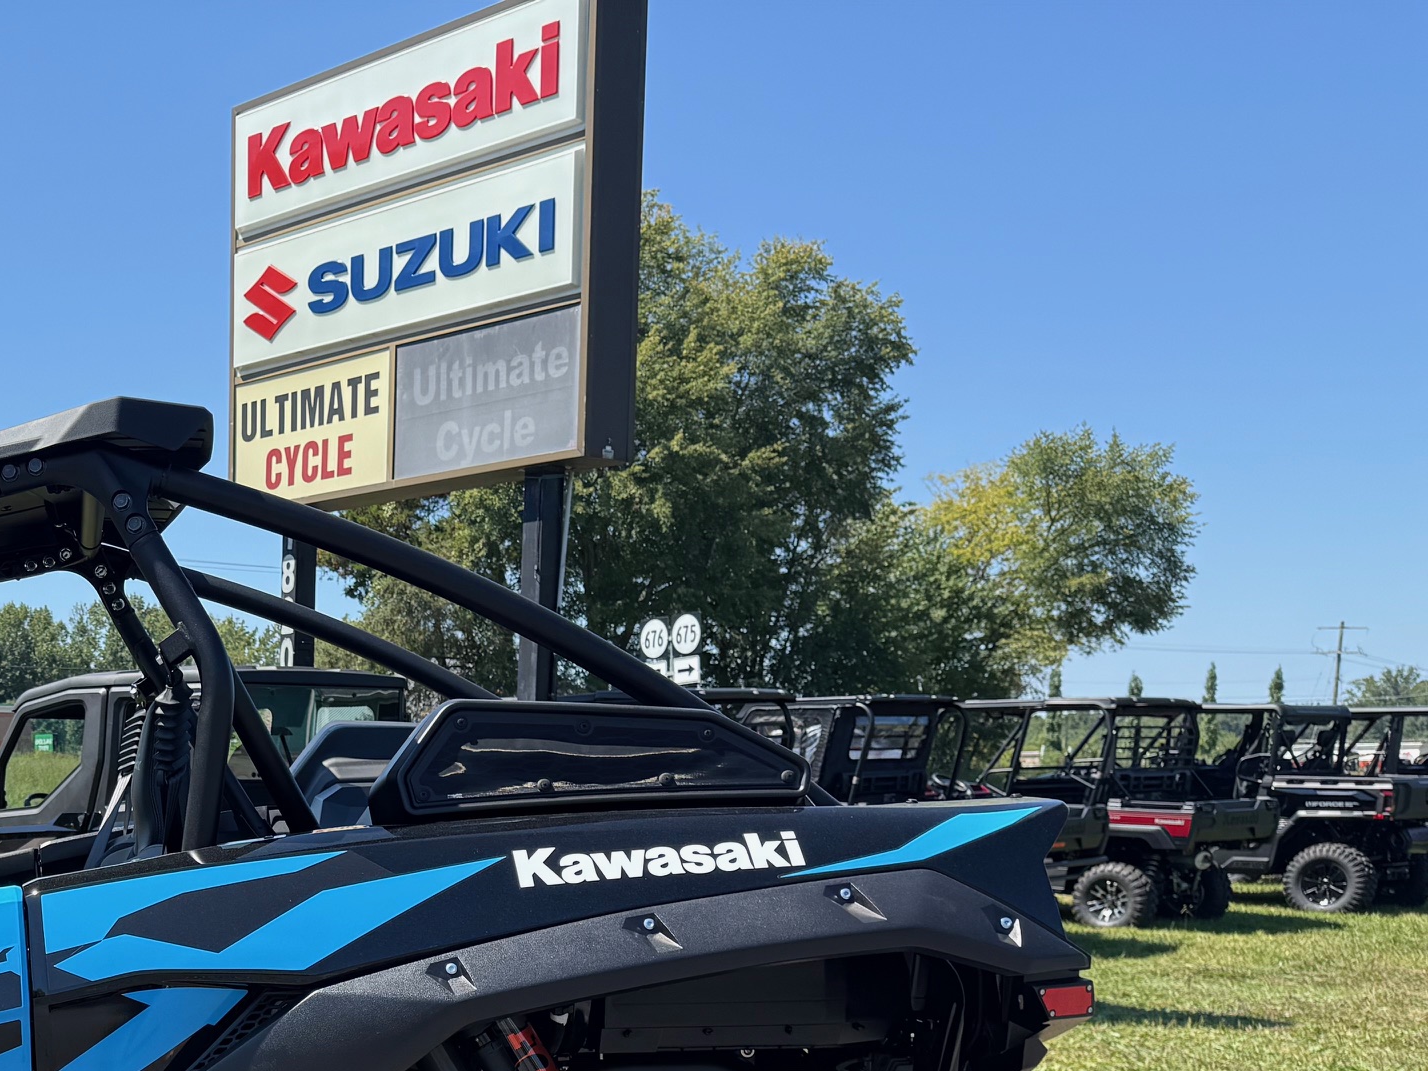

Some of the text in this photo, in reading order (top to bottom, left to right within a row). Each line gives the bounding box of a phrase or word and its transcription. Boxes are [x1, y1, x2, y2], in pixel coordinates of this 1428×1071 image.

[247, 20, 562, 200] Kawasaki
[307, 197, 556, 316] SUZUKI
[413, 341, 570, 406] Ultimate
[241, 371, 380, 443] ULTIMATE
[265, 433, 354, 491] CYCLE
[436, 409, 536, 468] Cycle
[644, 629, 664, 649] 676
[675, 624, 696, 645] 675
[512, 830, 807, 888] Kawasaki
